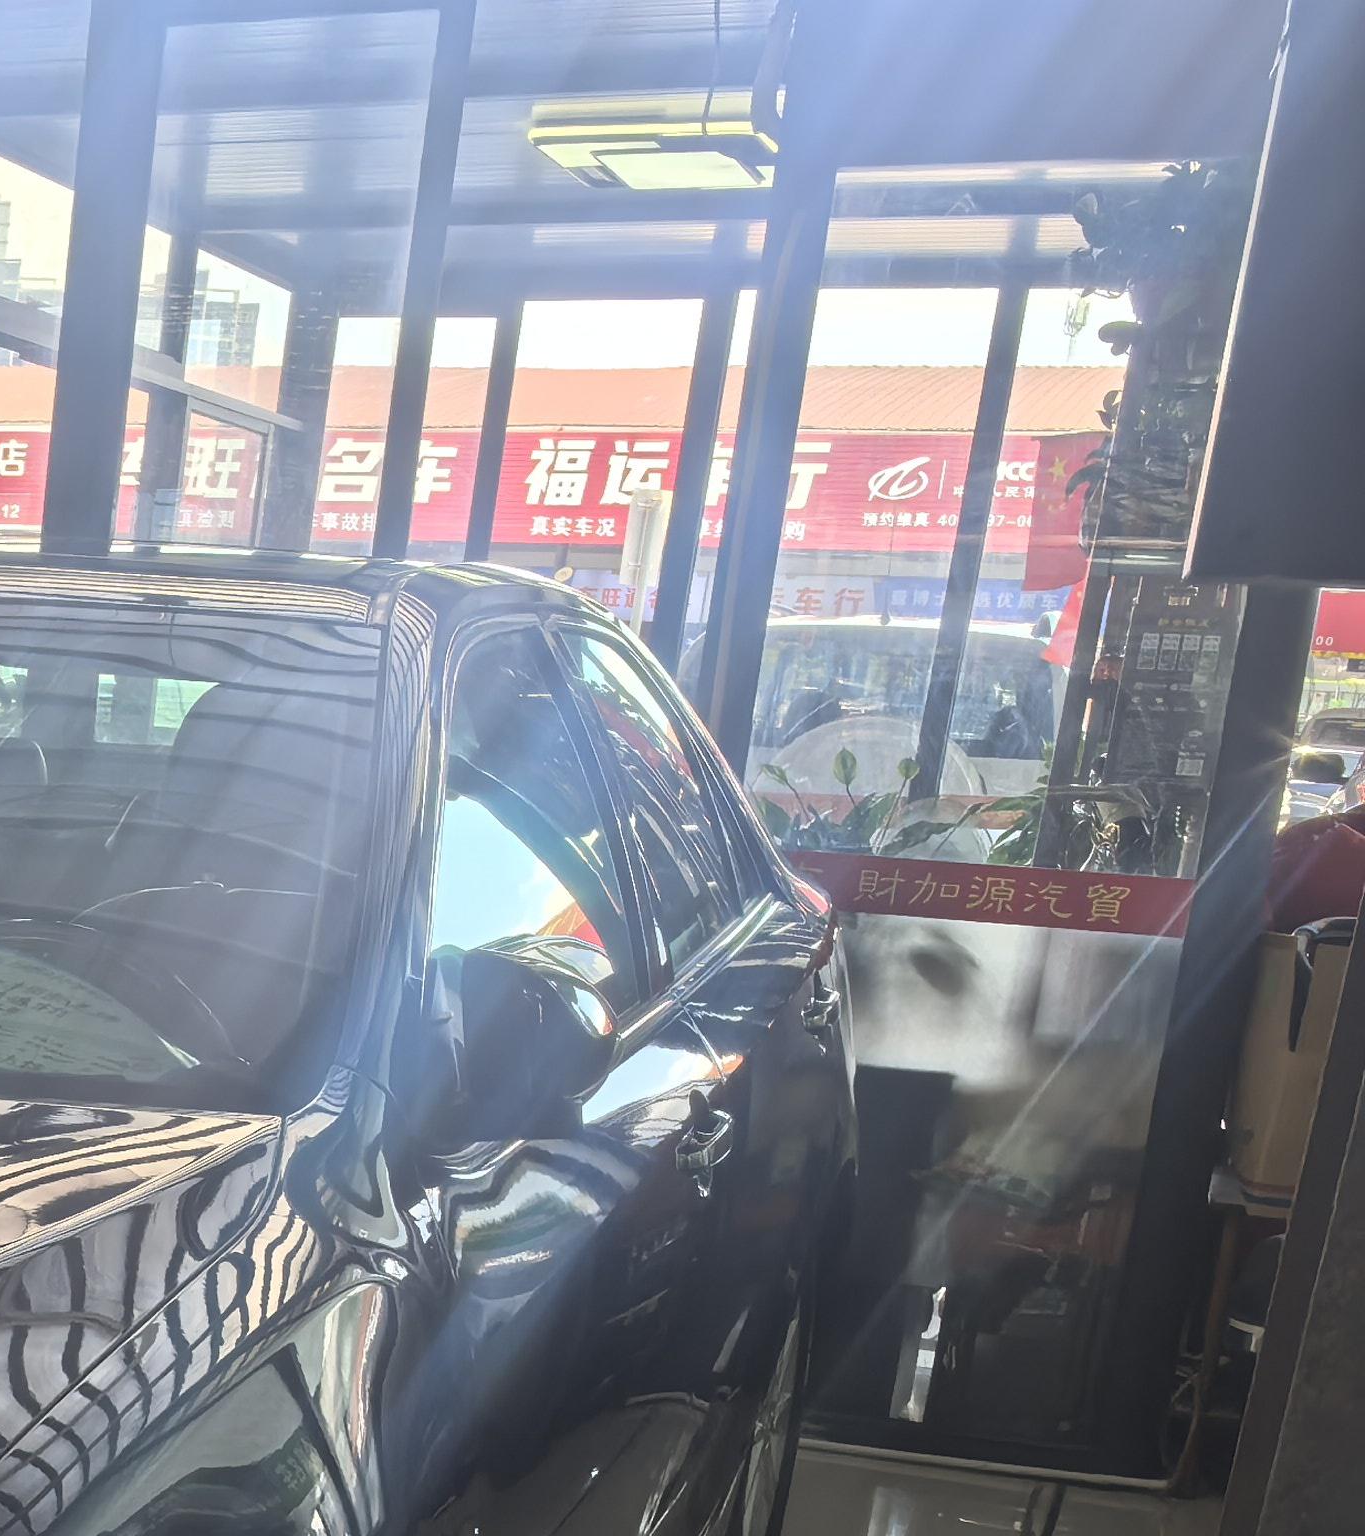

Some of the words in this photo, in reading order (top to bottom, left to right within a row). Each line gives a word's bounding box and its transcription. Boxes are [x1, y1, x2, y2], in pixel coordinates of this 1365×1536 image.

[530, 516, 617, 538] 真实车况
[797, 861, 1133, 925] 財加源汽貿
